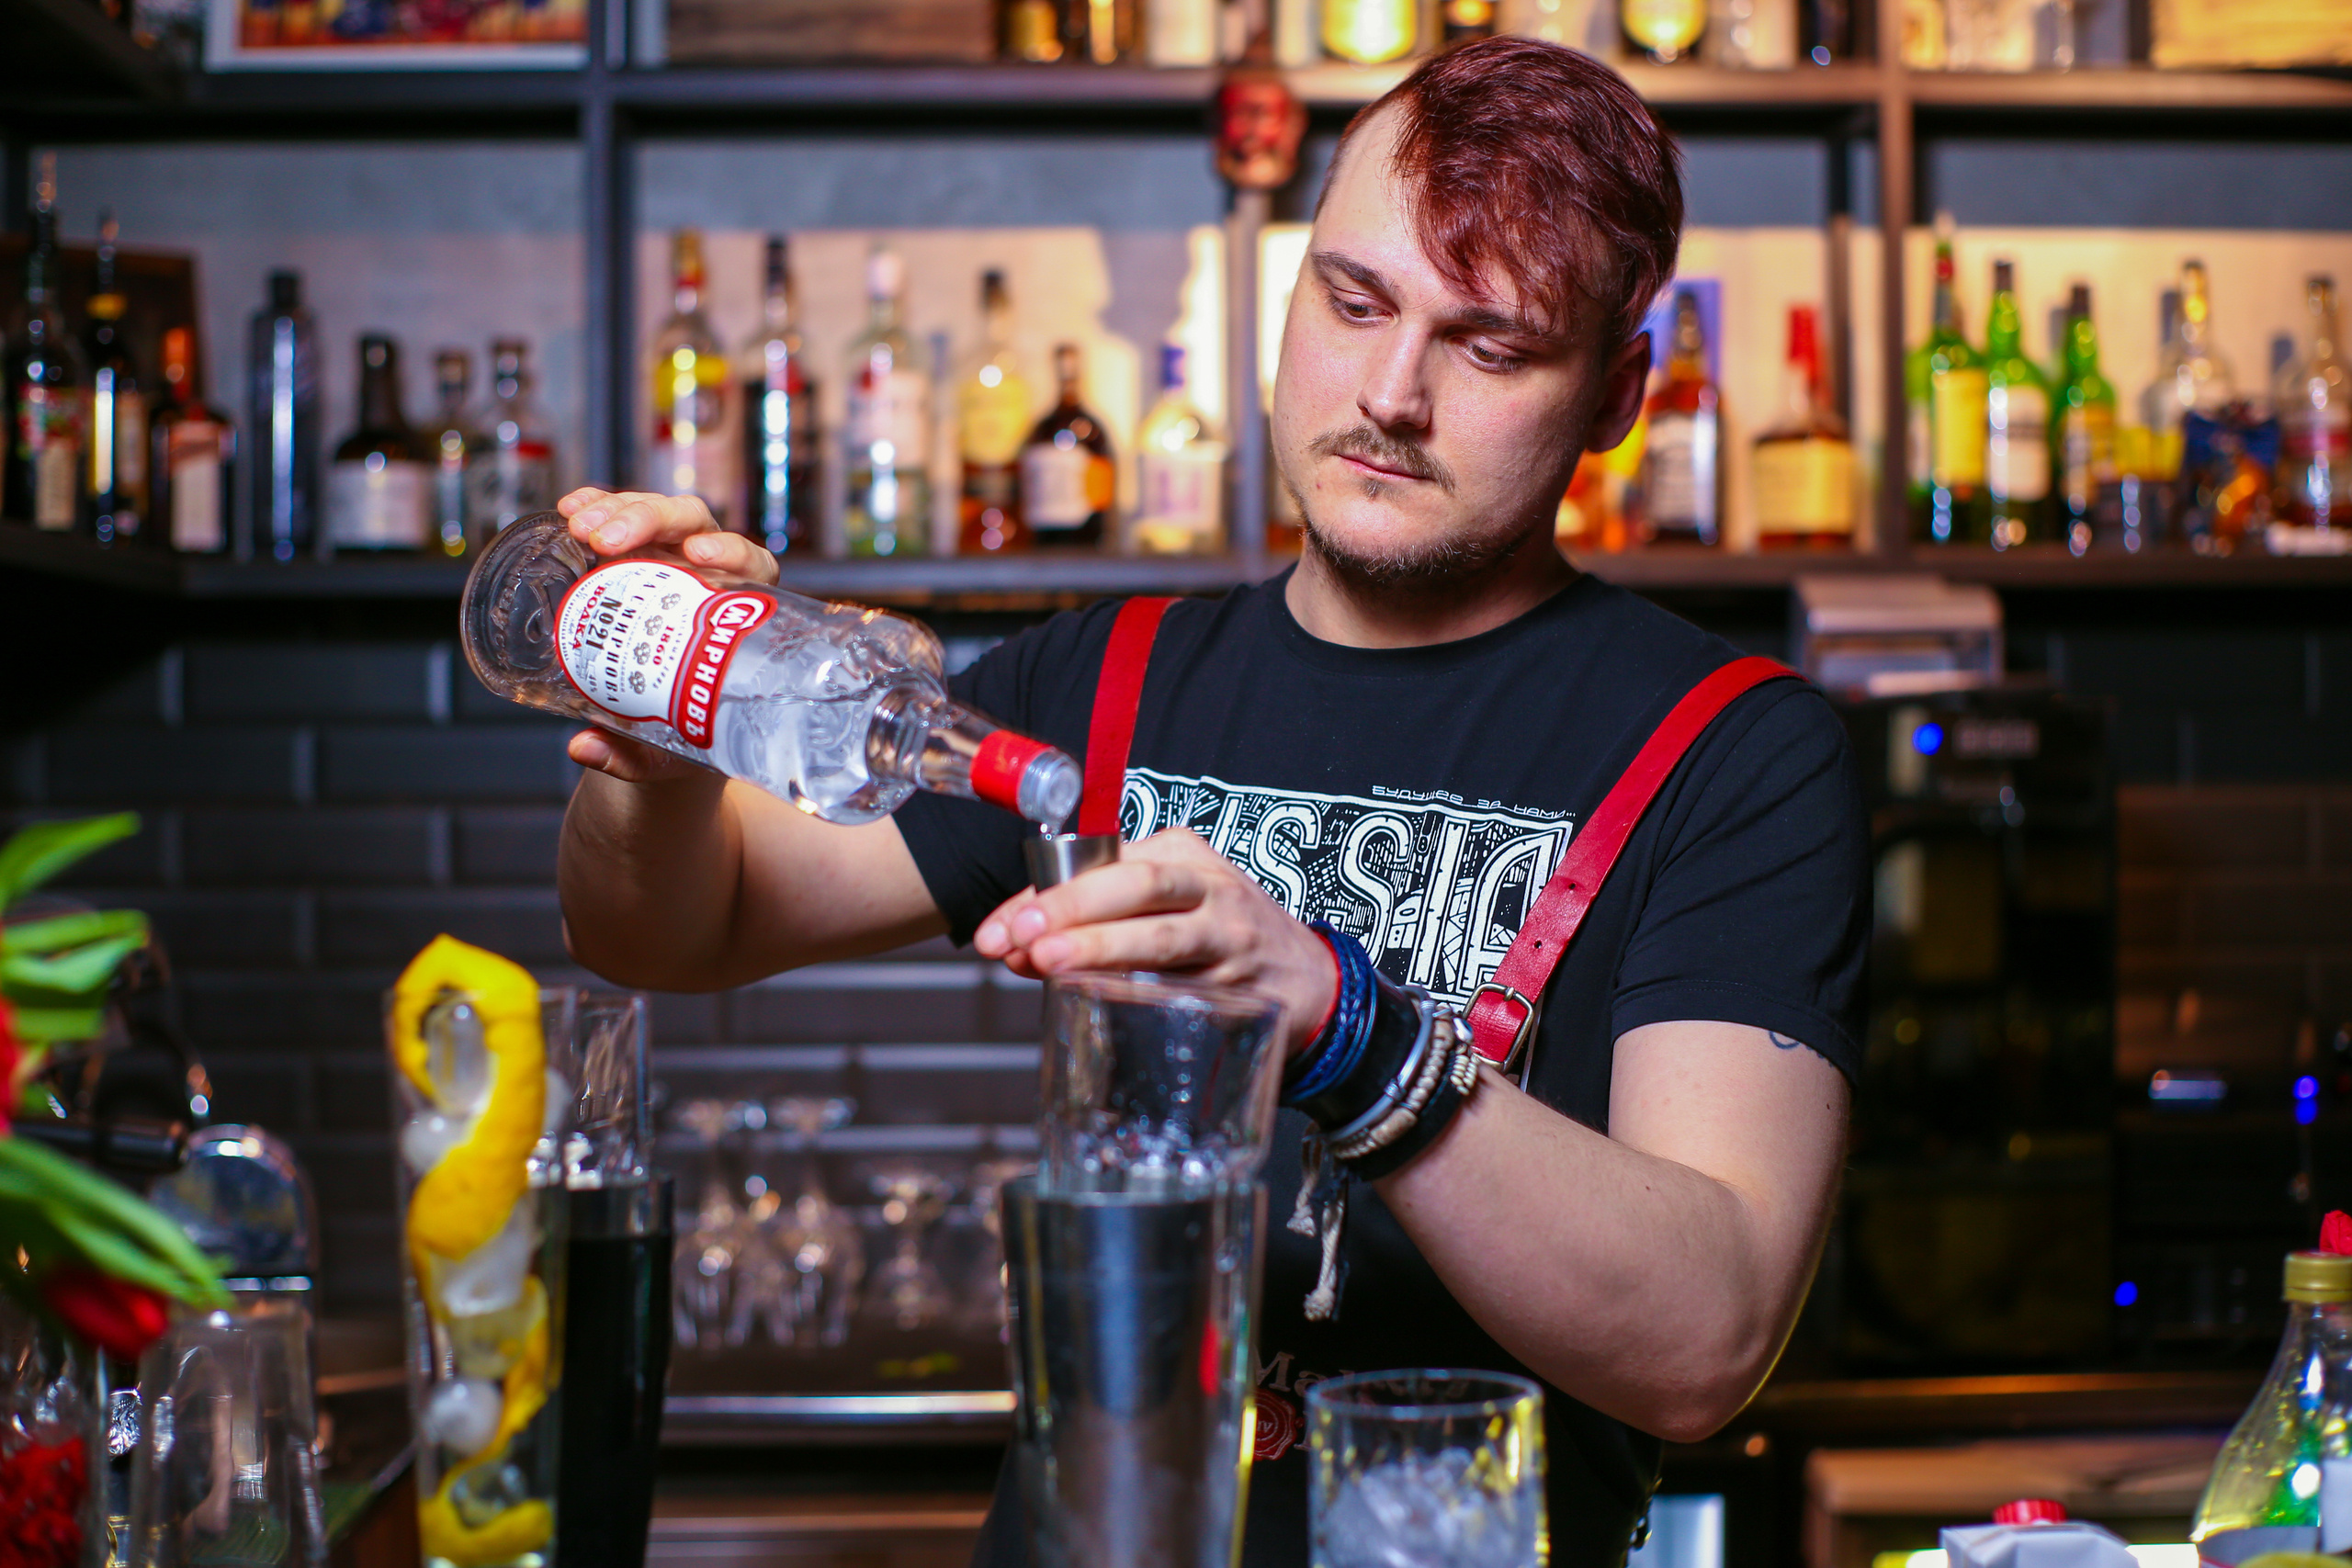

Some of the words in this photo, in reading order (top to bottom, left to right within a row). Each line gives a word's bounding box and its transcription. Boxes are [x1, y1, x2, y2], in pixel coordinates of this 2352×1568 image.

[571, 585, 607, 650] ВОДКА
[652, 626, 675, 666] 1860
[685, 597, 764, 737] СМИРНОВЪ
